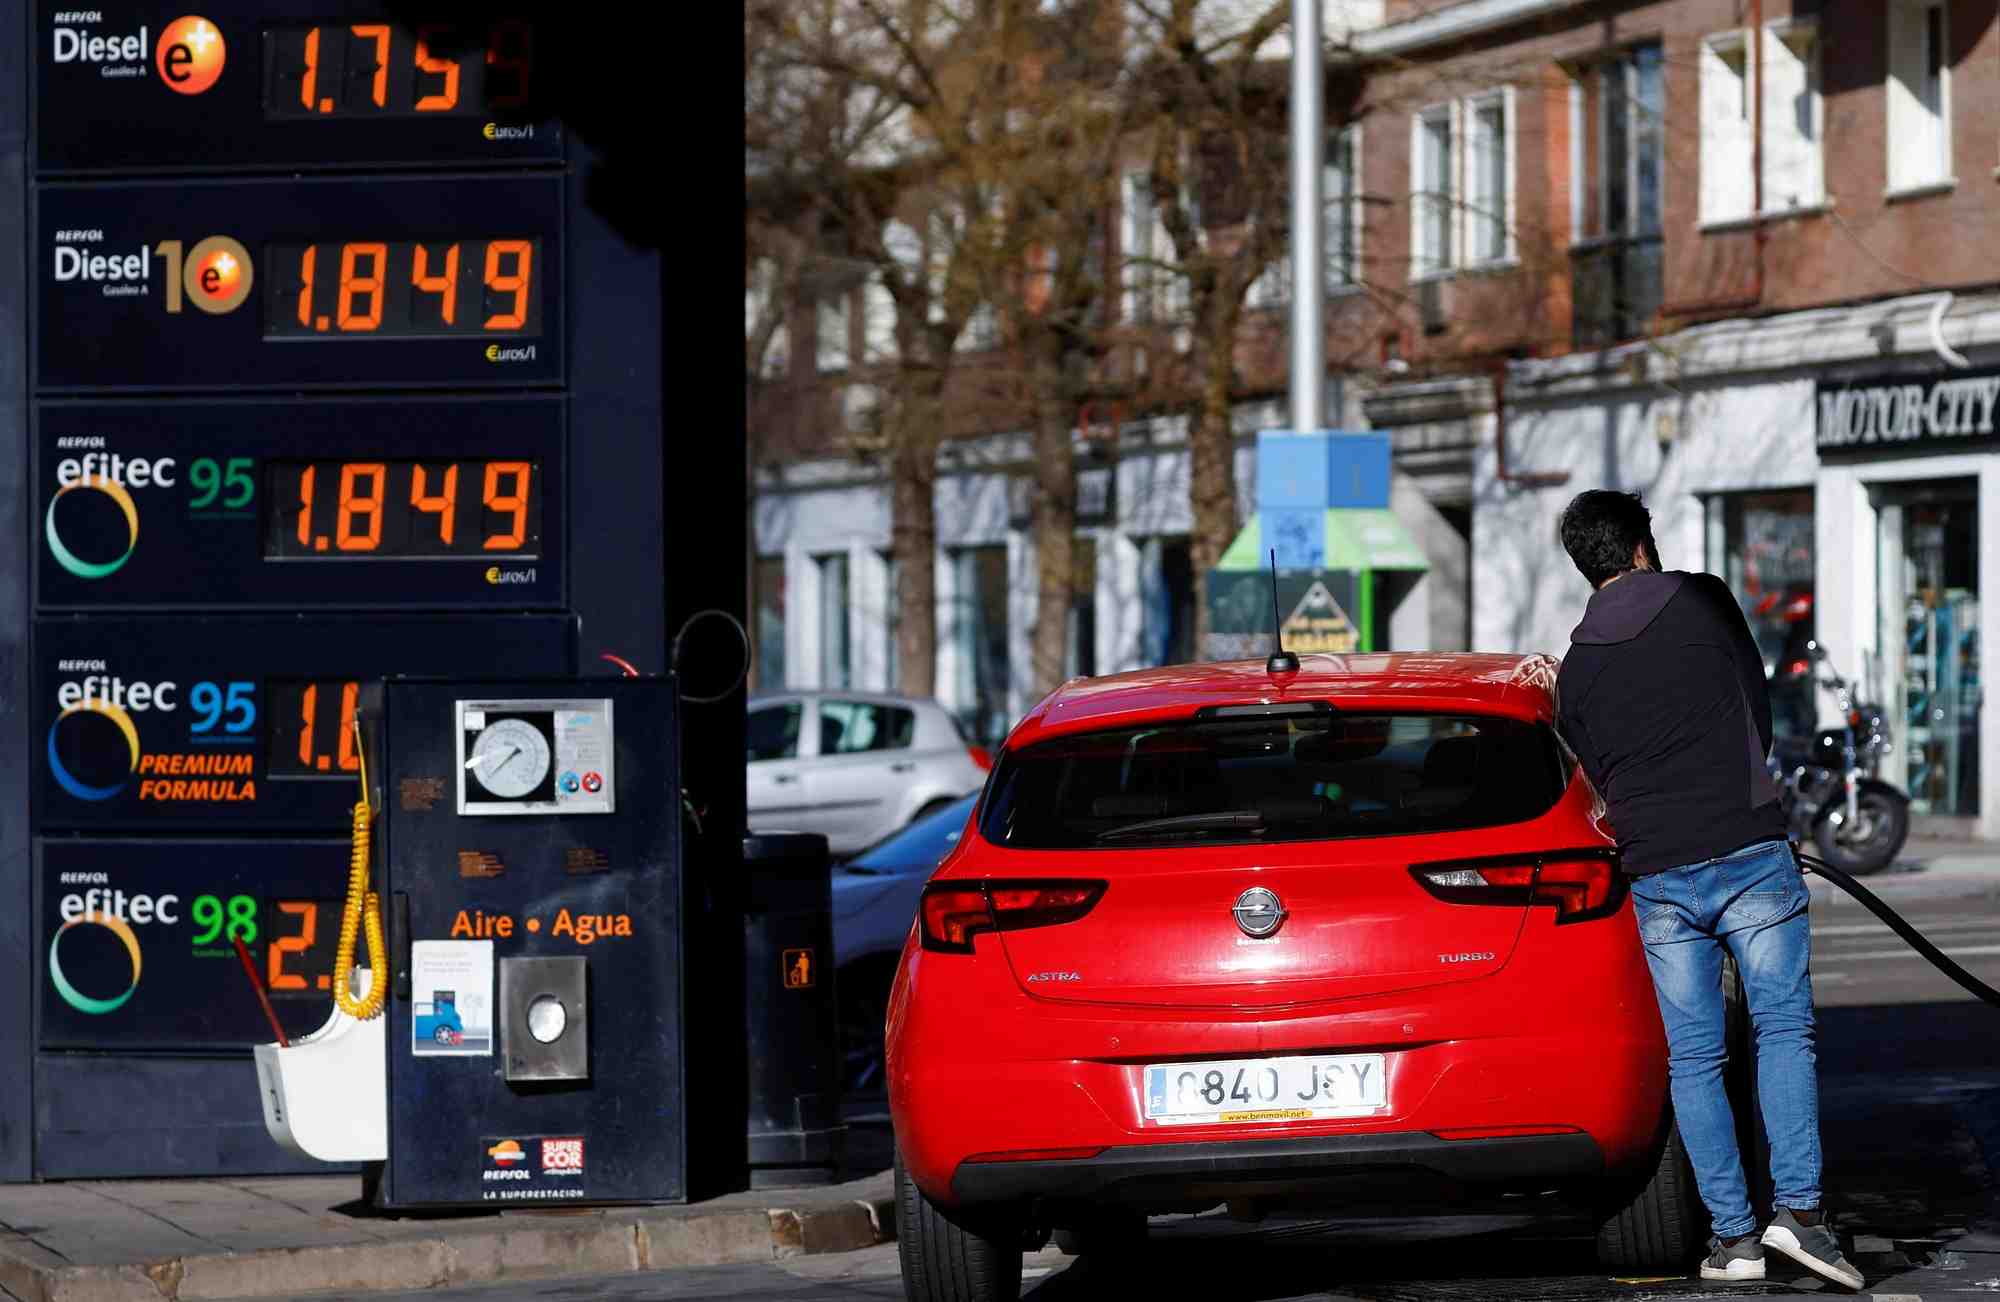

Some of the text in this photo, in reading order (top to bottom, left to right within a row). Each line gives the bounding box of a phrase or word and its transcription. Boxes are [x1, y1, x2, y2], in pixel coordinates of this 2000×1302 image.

[54, 26, 147, 62] Diesel
[55, 245, 149, 281] Diesel
[298, 241, 532, 331] 1.849
[57, 453, 255, 508] efitec 95
[298, 461, 530, 551] 1.849
[58, 676, 257, 733] efitec 95
[139, 753, 254, 775] PREMIUM
[139, 780, 257, 801] FORMULA
[60, 889, 257, 946] efitec 98
[451, 908, 632, 945] Aire Agua
[1439, 951, 1496, 964] TURBO
[1027, 971, 1081, 983] ASTRA
[542, 1140, 583, 1153] SUPER
[542, 1152, 583, 1169] COR
[483, 1169, 531, 1181] REPSOL
[483, 1190, 497, 1200] LA
